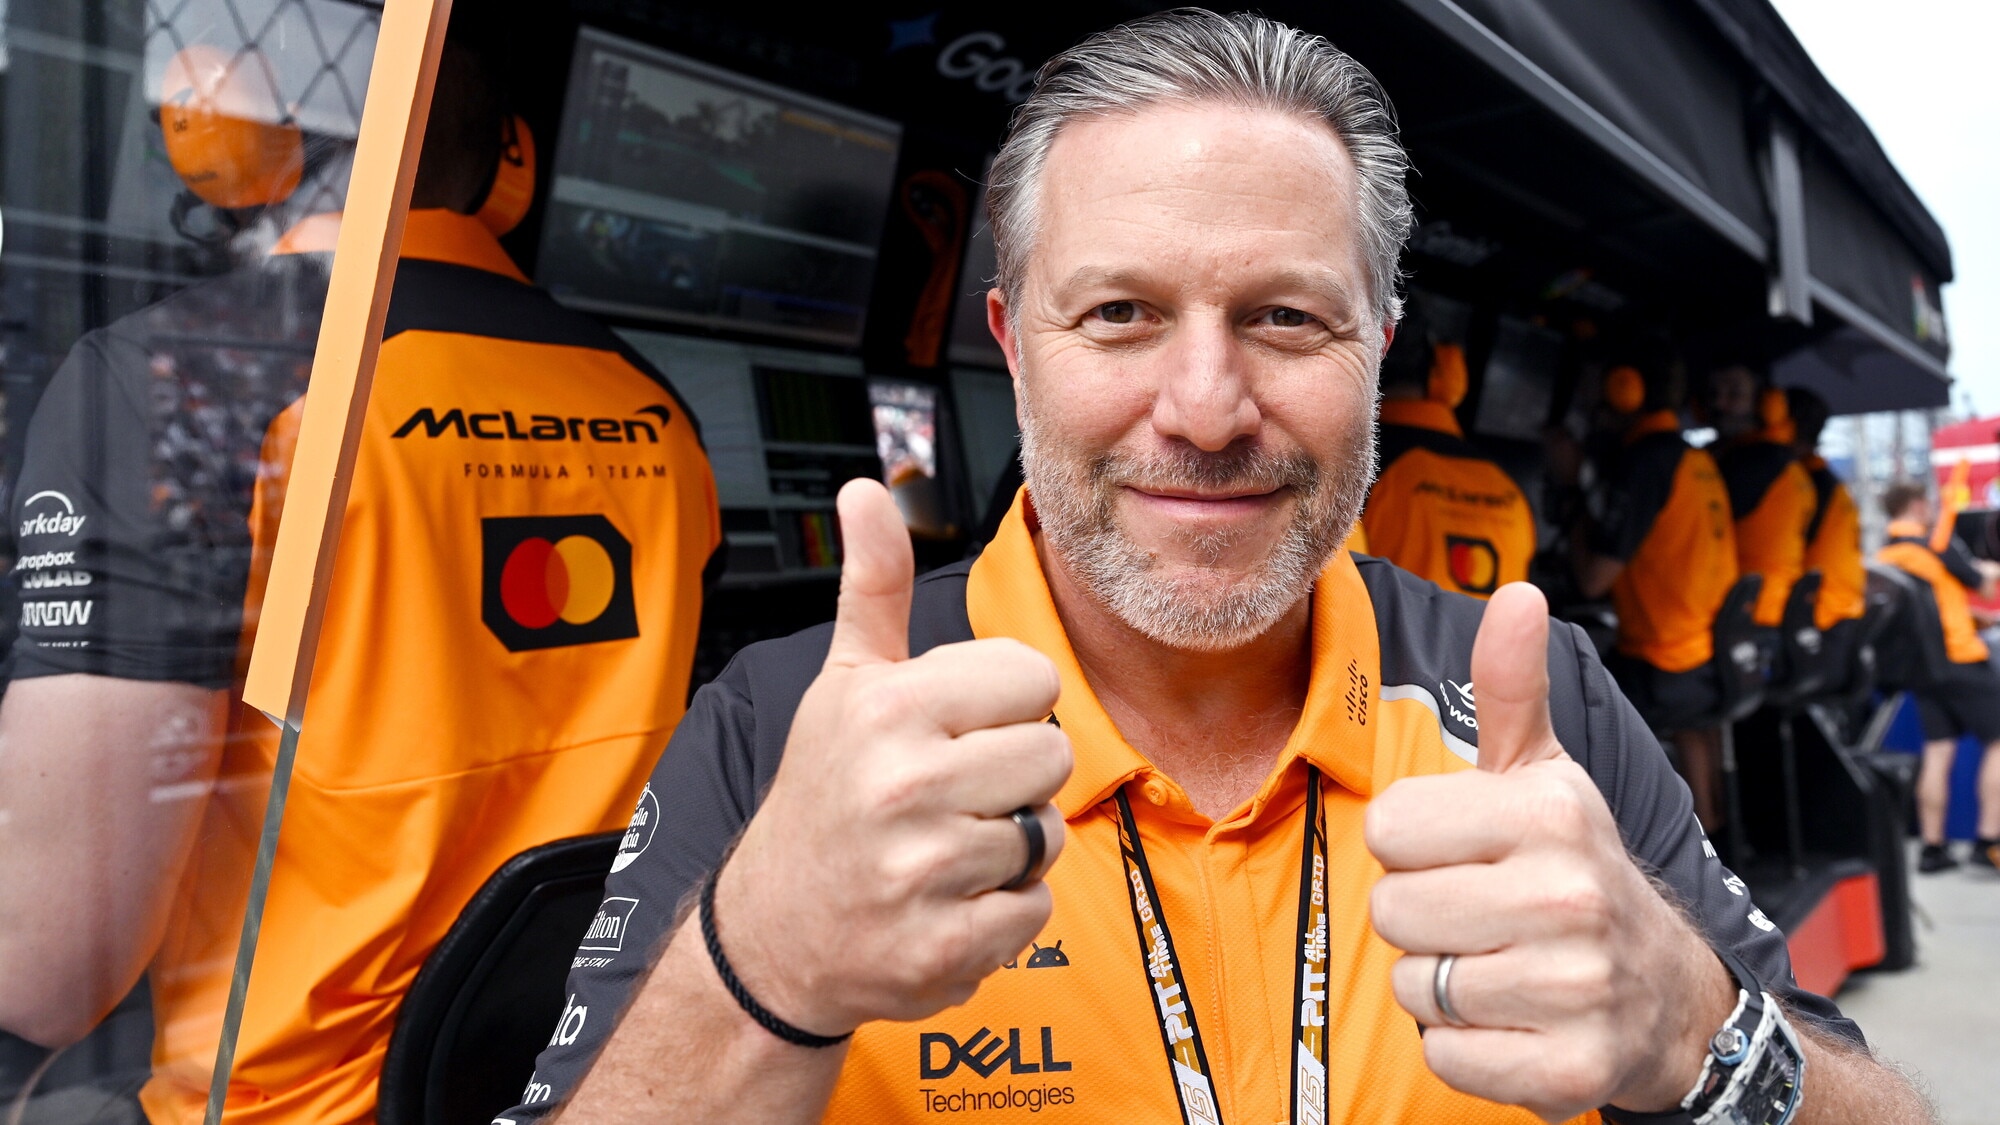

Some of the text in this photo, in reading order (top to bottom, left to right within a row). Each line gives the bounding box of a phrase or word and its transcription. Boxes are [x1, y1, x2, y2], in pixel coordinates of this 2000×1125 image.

[390, 405, 669, 443] McLaren
[464, 463, 666, 478] FORMULA 1 TEAM
[1357, 674, 1368, 726] CISCO
[1450, 705, 1479, 731] WO
[1130, 869, 1153, 923] GRID
[1312, 854, 1325, 905] GRID
[583, 911, 621, 939] ilton
[547, 994, 588, 1047] ta
[919, 1026, 1072, 1080] DELL
[919, 1083, 1075, 1112] Technologies
